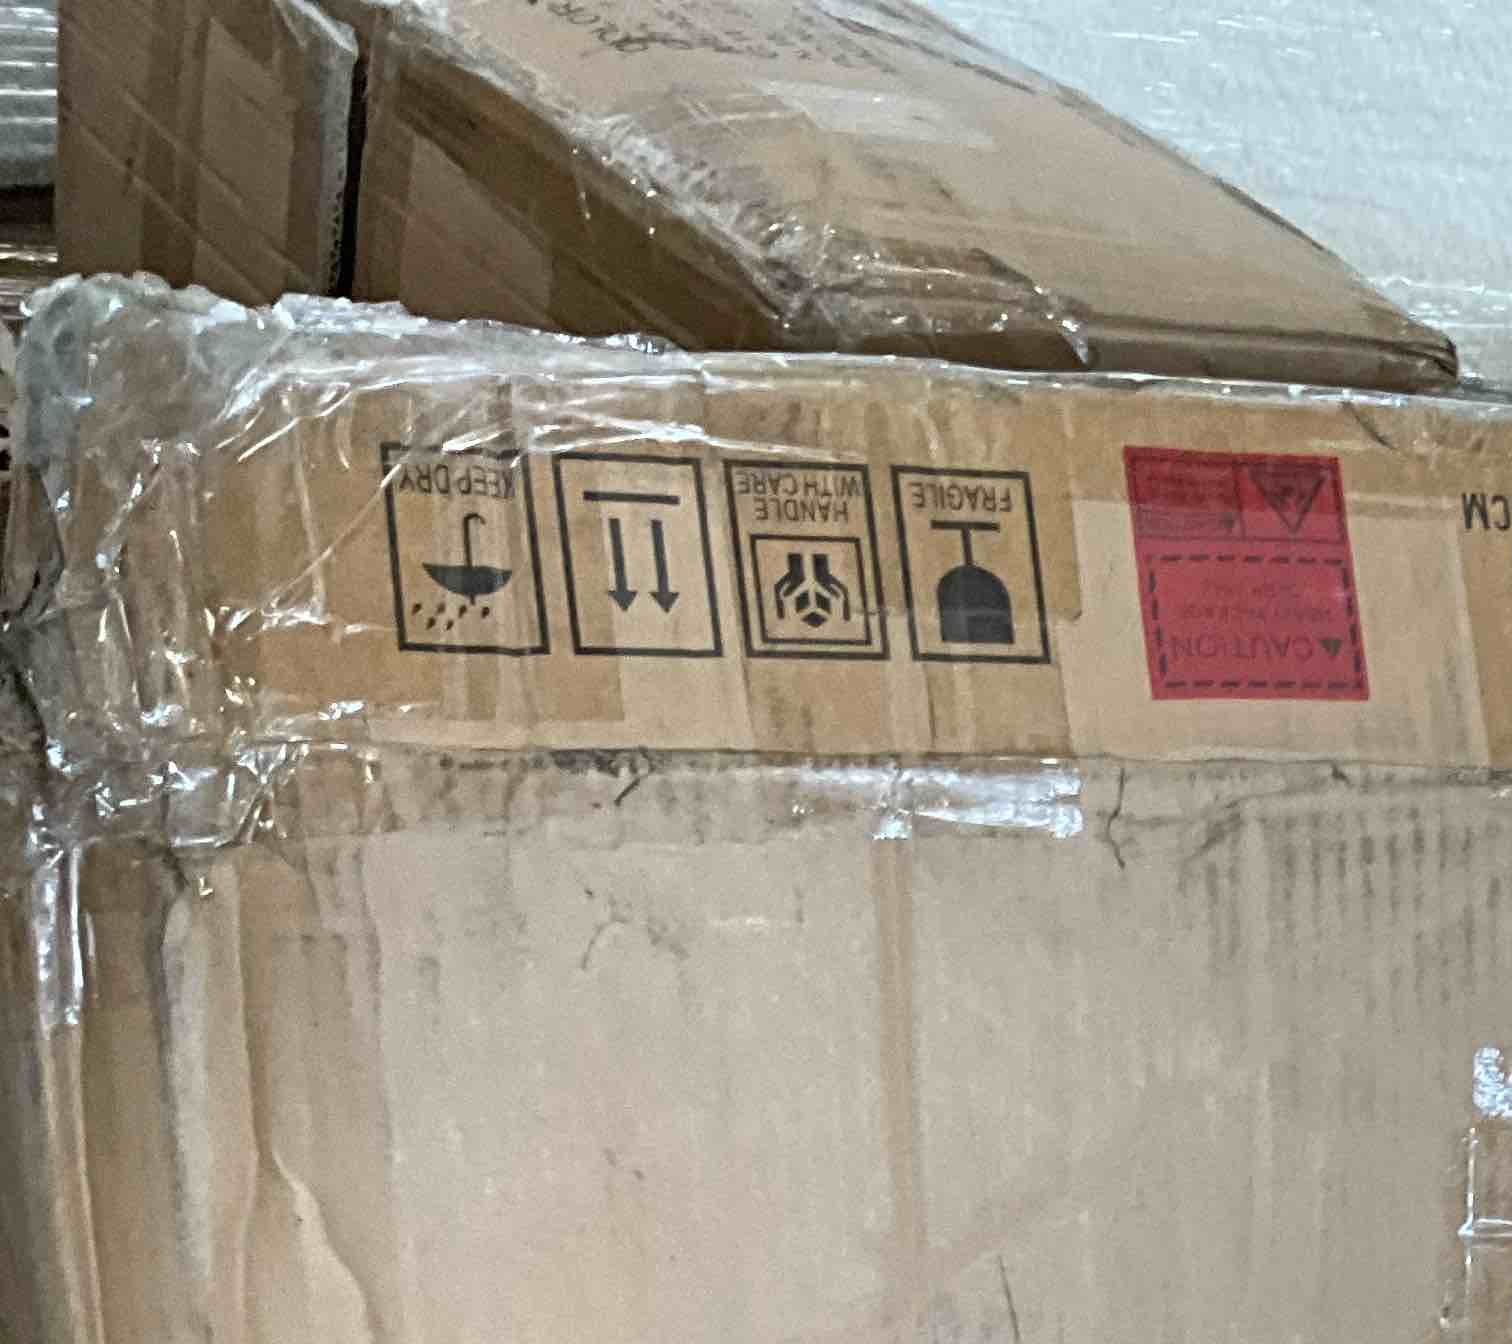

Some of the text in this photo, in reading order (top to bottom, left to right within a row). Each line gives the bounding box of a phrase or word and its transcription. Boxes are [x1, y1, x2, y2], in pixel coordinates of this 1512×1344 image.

[400, 463, 514, 499] KEEP DRY
[735, 470, 865, 497] WITH CARE
[754, 498, 849, 522] HANDLE
[911, 482, 1013, 512] FRAGILE
